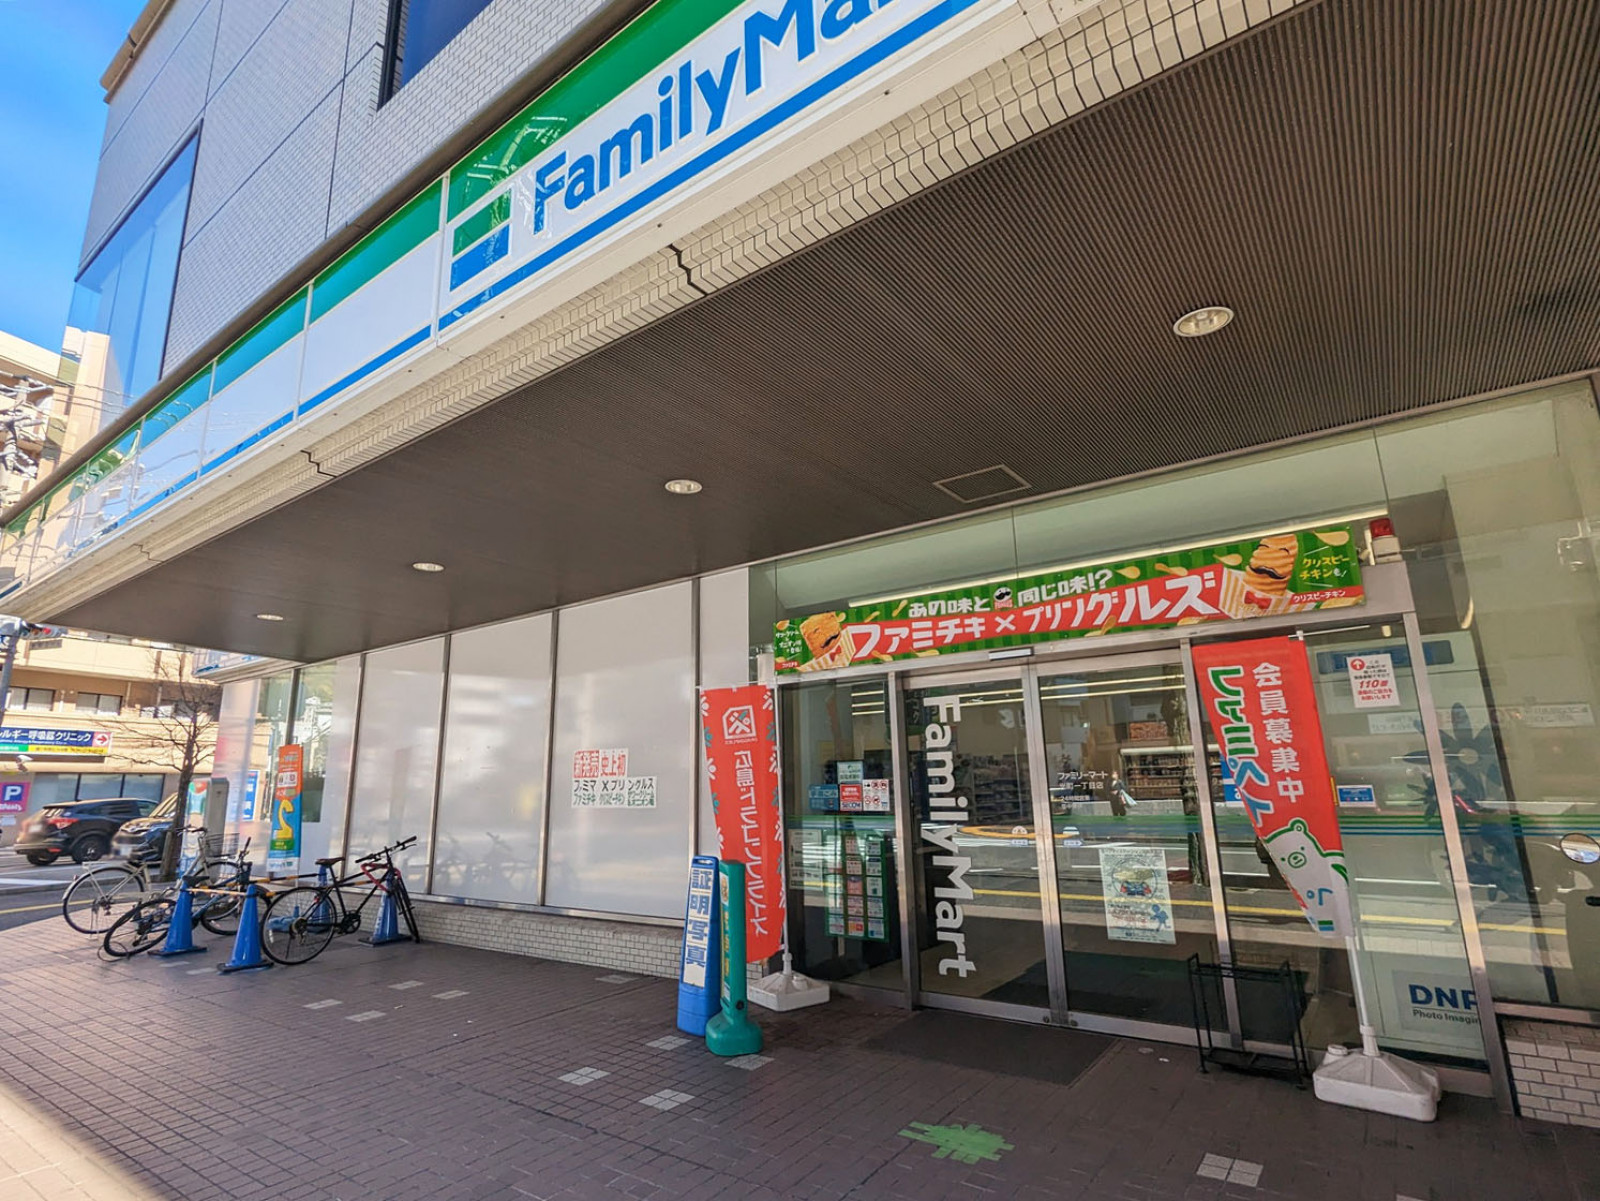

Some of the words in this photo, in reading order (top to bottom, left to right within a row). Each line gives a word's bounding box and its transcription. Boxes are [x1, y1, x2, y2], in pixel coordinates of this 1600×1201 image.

[532, 0, 895, 236] FamilyMa
[1302, 554, 1350, 568] クリスピー
[1293, 590, 1346, 603] クリスピーチキン
[908, 597, 991, 619] あの味と
[1057, 770, 1109, 781] ファミリーマート
[4, 785, 22, 801] P
[921, 694, 977, 979] FamilyMart
[686, 868, 713, 969] 証明写真
[1412, 1008, 1443, 1020] Photo
